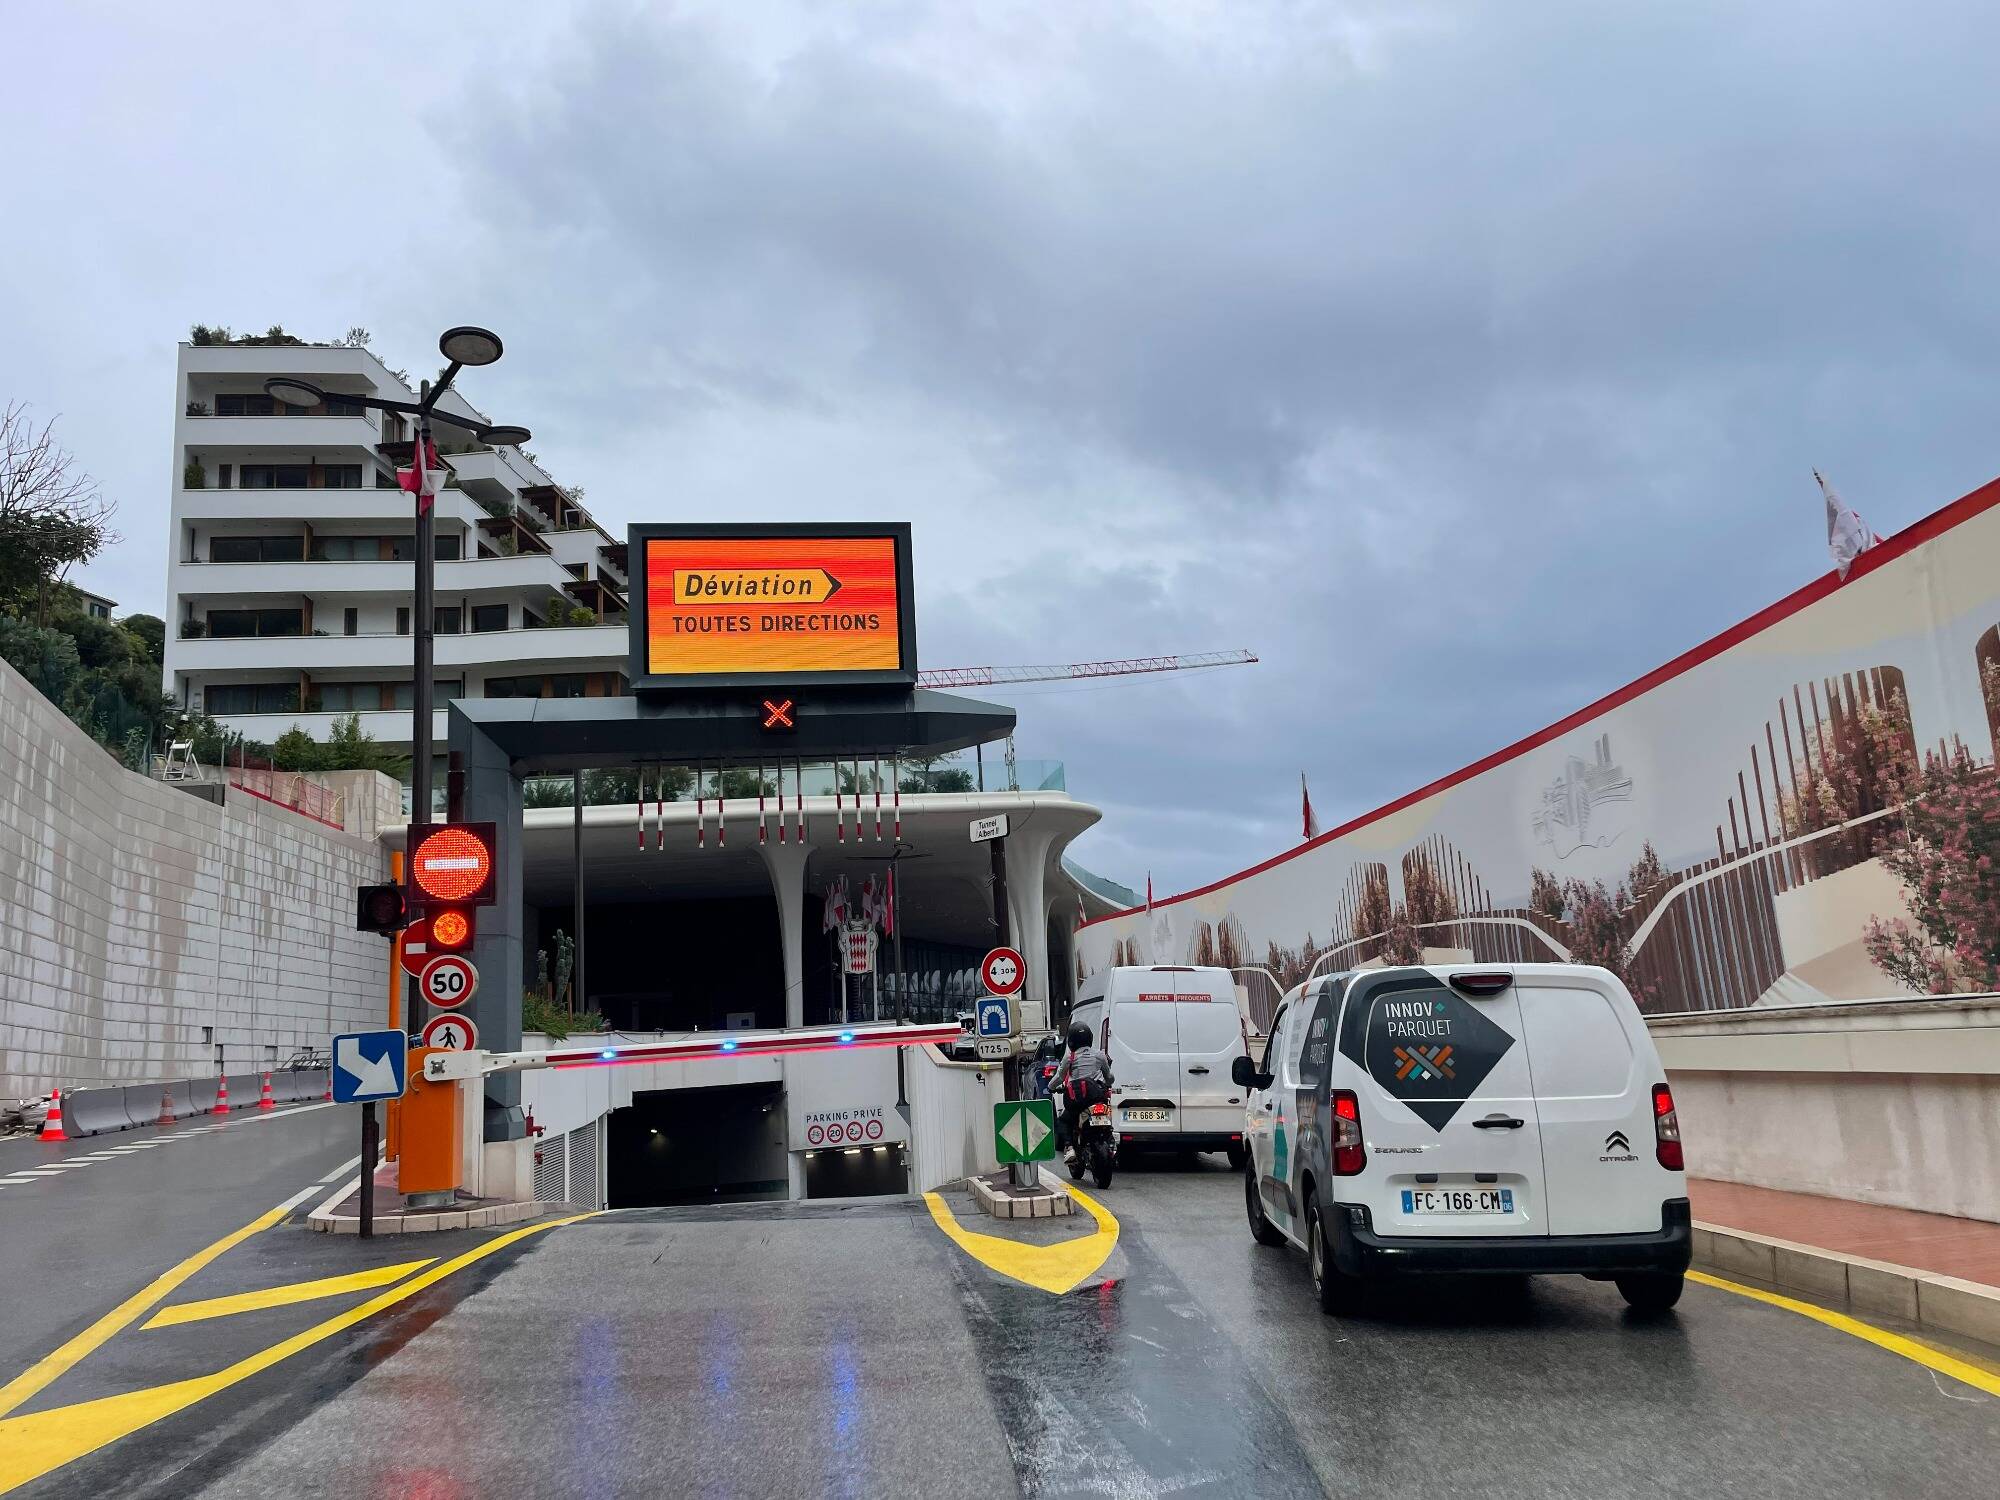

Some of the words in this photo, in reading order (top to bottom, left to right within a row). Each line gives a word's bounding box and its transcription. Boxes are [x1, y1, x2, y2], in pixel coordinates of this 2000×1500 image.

[684, 573, 813, 597] Déviation
[672, 616, 751, 633] TOUTES
[761, 613, 880, 632] DIRECTIONS
[978, 819, 996, 829] Tunnel
[977, 828, 995, 838] Albert
[432, 973, 464, 994] 50
[1384, 1001, 1433, 1018] INNOV
[1387, 1019, 1452, 1038] PARQUET
[979, 1044, 1002, 1055] 1725
[806, 1111, 849, 1124] PARKING
[853, 1108, 883, 1120] PRIVE
[829, 1129, 841, 1138] 20
